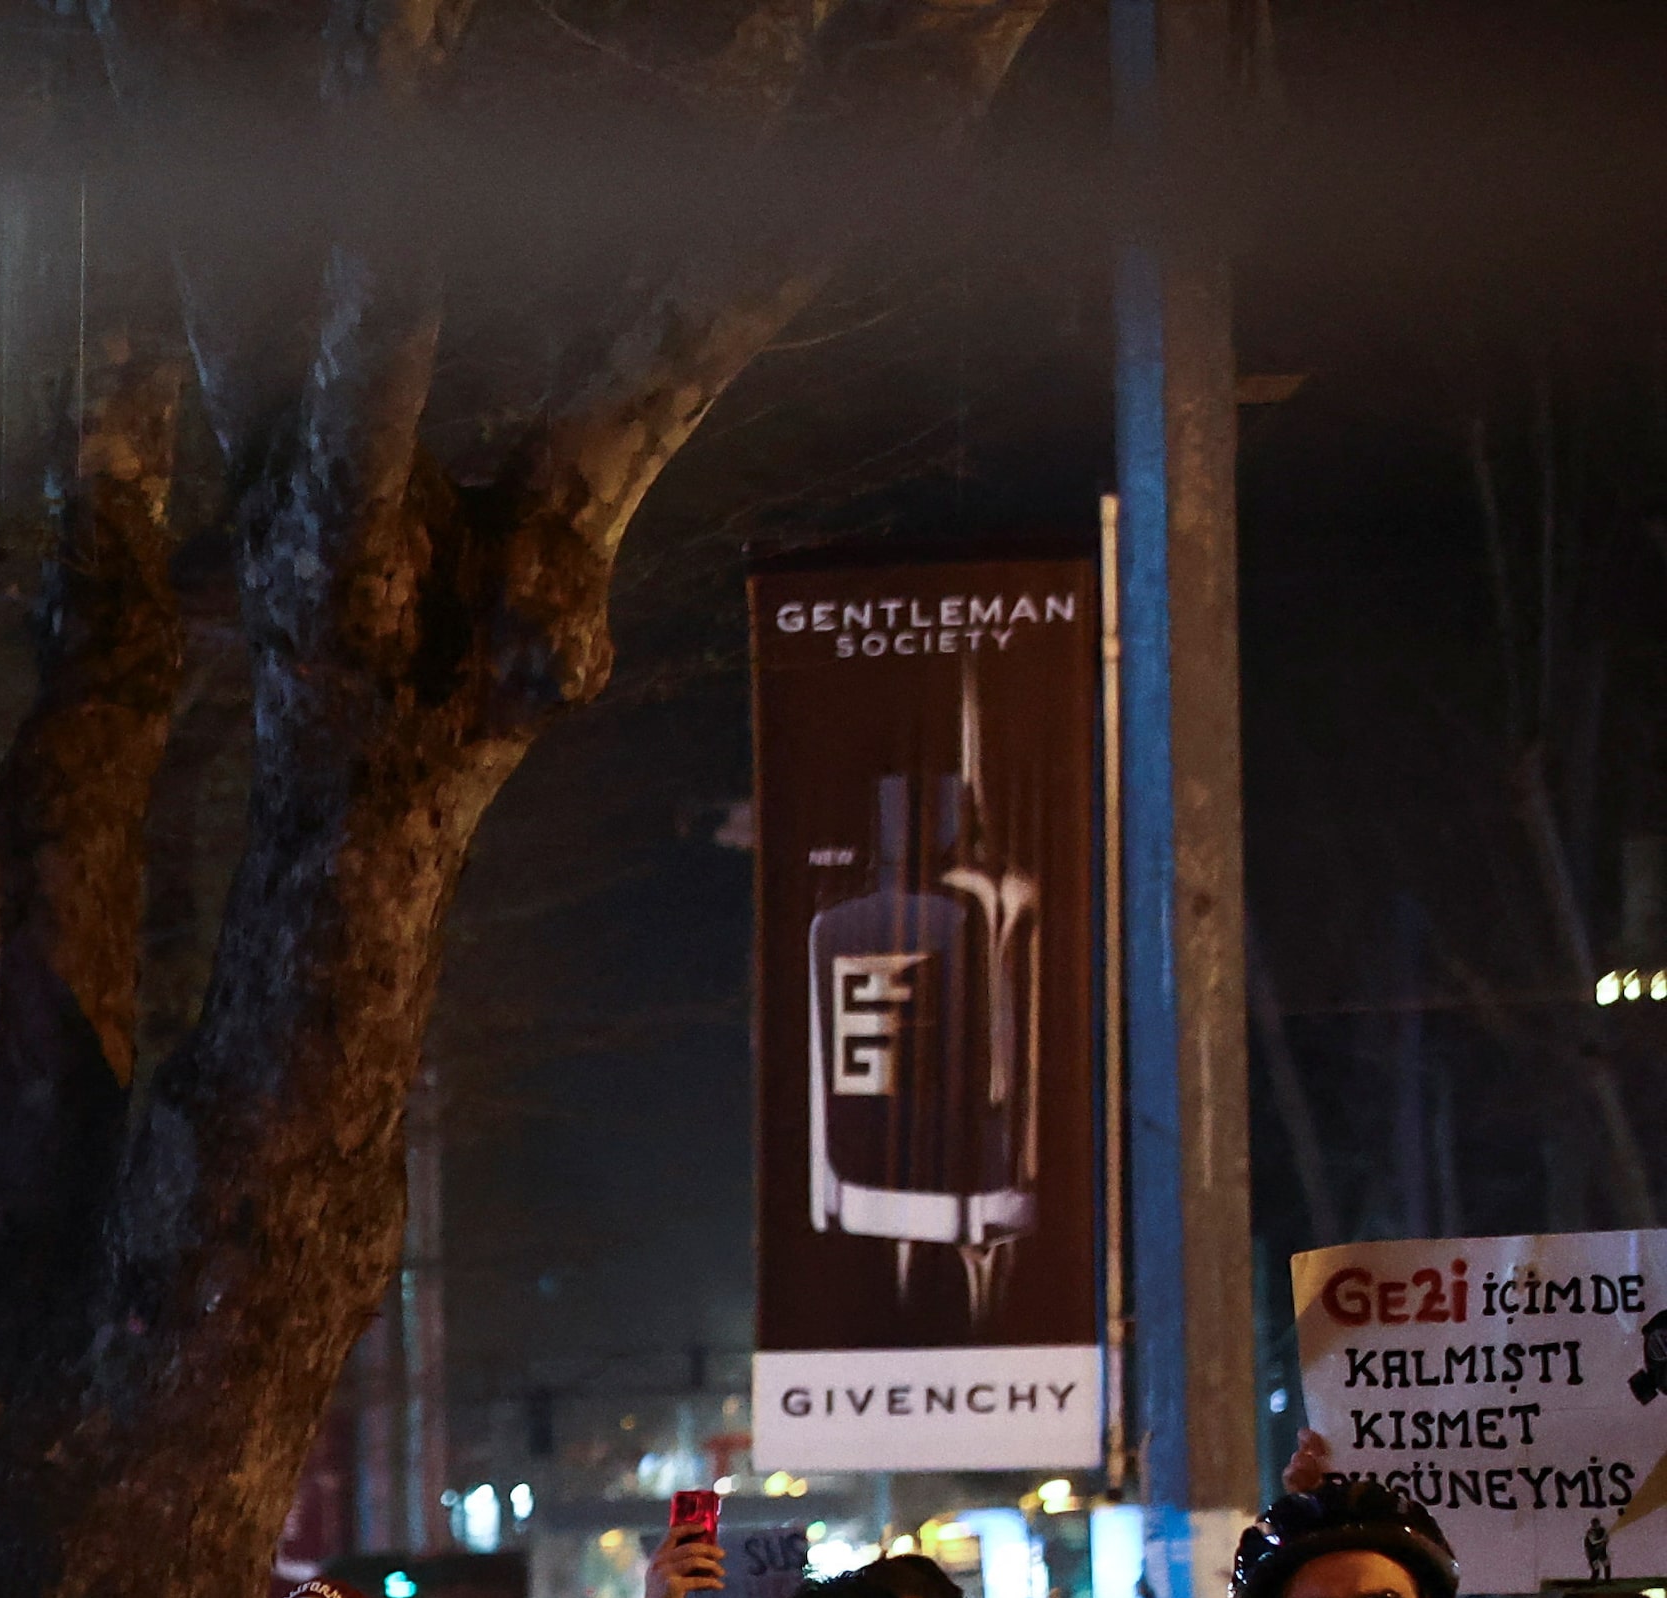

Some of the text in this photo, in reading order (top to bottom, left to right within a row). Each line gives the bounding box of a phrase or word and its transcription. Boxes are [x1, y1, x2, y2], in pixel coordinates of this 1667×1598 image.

[775, 591, 1077, 634] GENTLEMAN
[835, 627, 1014, 660] SOCIETY
[1344, 1340, 1584, 1394] KALMIŞTI
[781, 1380, 1077, 1418] GIVENCHY
[1350, 1402, 1541, 1450] KISMET
[1322, 1455, 1636, 1516] GÜNEYMİŞ
